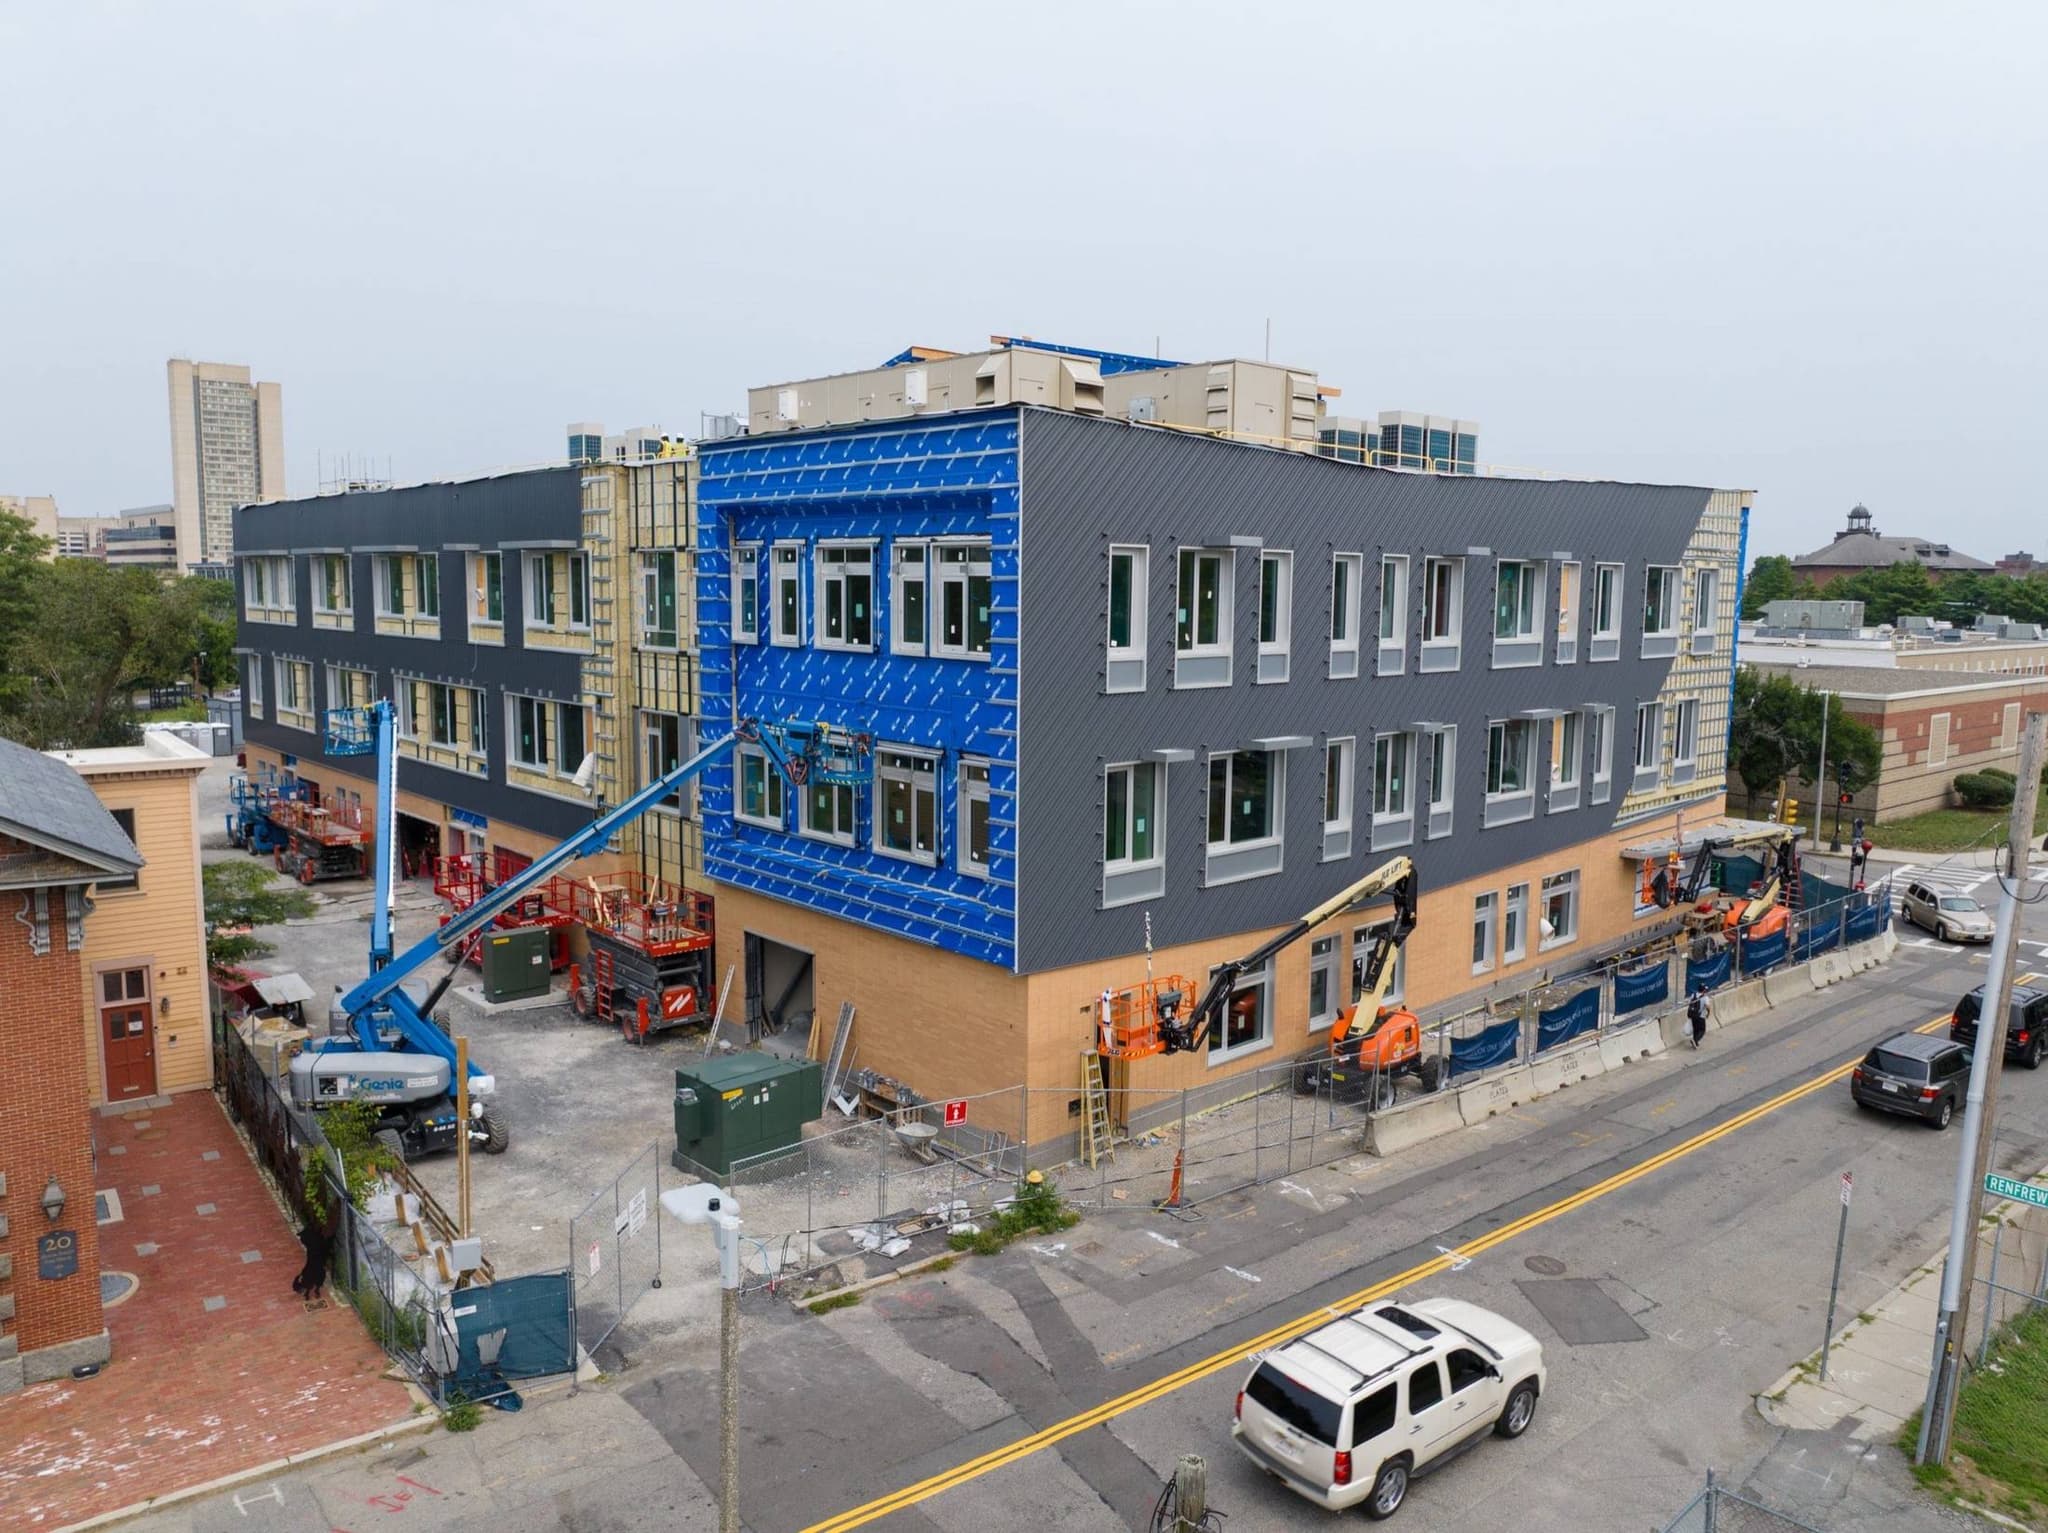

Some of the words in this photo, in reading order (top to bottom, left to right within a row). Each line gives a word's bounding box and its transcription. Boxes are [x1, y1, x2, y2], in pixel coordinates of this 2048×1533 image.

[359, 1077, 405, 1090] Genie
[1990, 1177, 2047, 1204] RENFREW
[46, 1236, 71, 1252] 20
